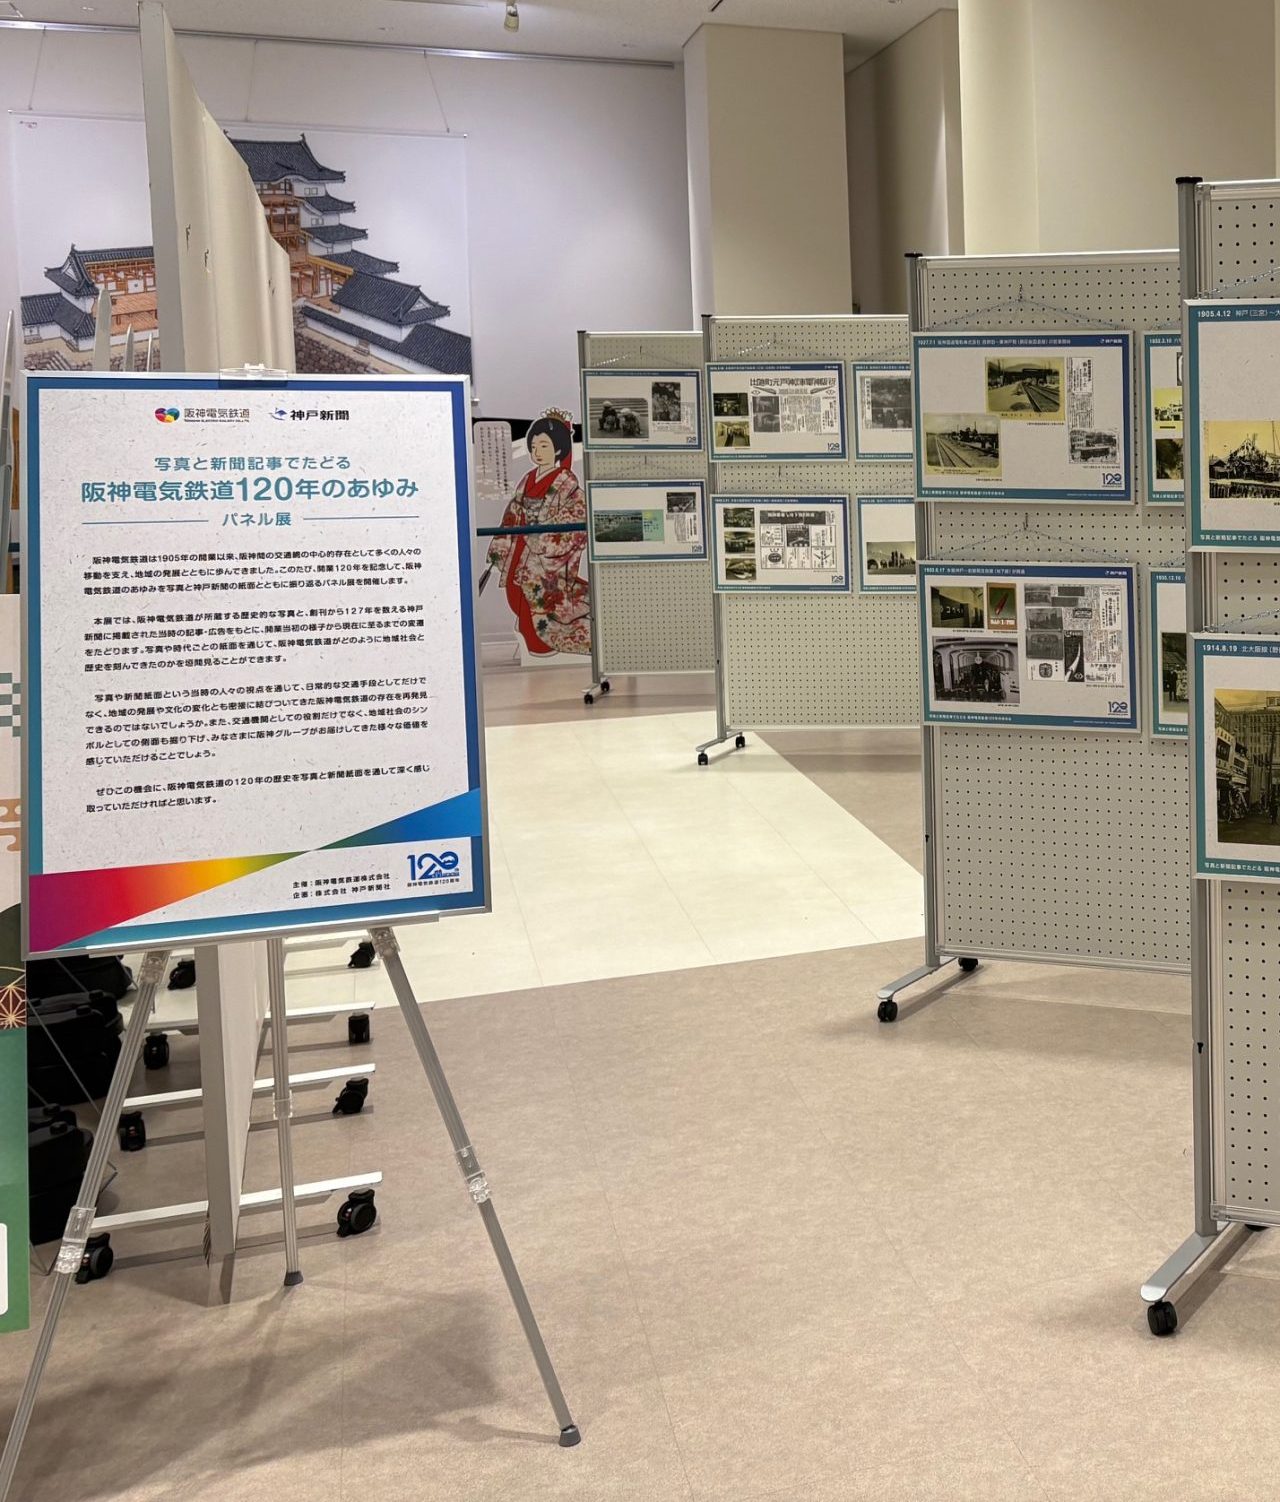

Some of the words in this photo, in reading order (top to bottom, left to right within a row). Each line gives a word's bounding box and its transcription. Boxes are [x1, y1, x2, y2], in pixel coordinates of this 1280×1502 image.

[1198, 309, 1231, 318] 1905.4.12
[184, 408, 250, 419] 阪神電気鉄道
[290, 409, 350, 421] 神戸新聞
[154, 456, 351, 472] 写真と新聞記事でたどる
[81, 476, 420, 503] 阪神電気鉄道120年のあゆみ
[222, 512, 292, 528] パネル展
